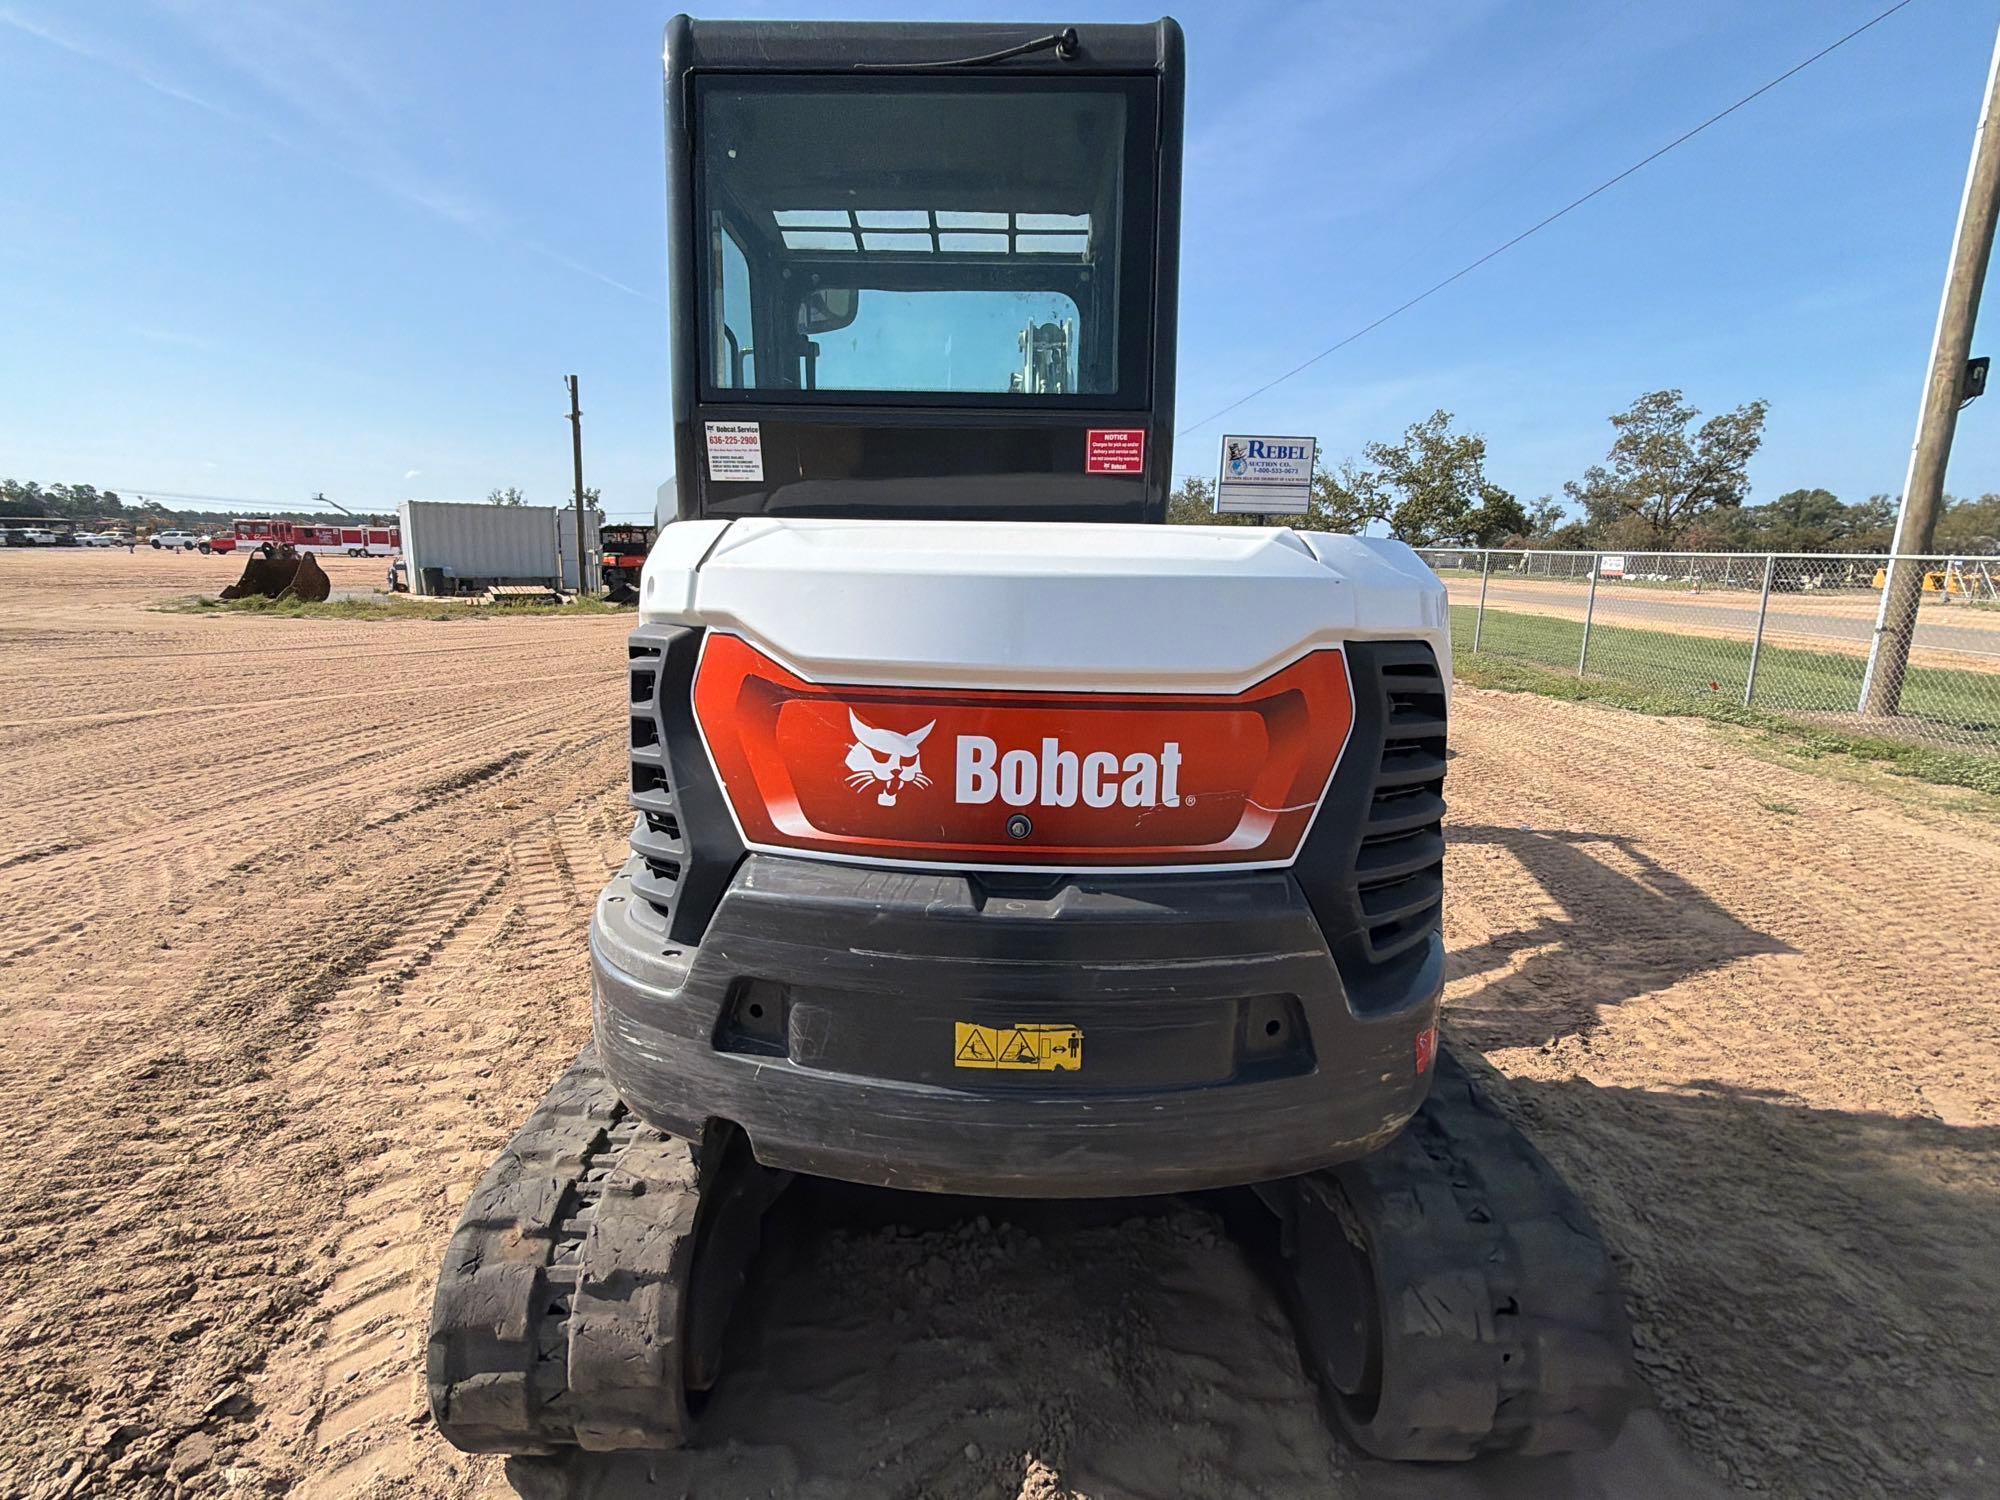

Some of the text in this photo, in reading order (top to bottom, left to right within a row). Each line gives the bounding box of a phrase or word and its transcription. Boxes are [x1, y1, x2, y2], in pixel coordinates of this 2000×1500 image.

[709, 436, 758, 445] 636-225-2900
[1248, 440, 1310, 460] REBEL
[955, 735, 1182, 808] Bobcat
